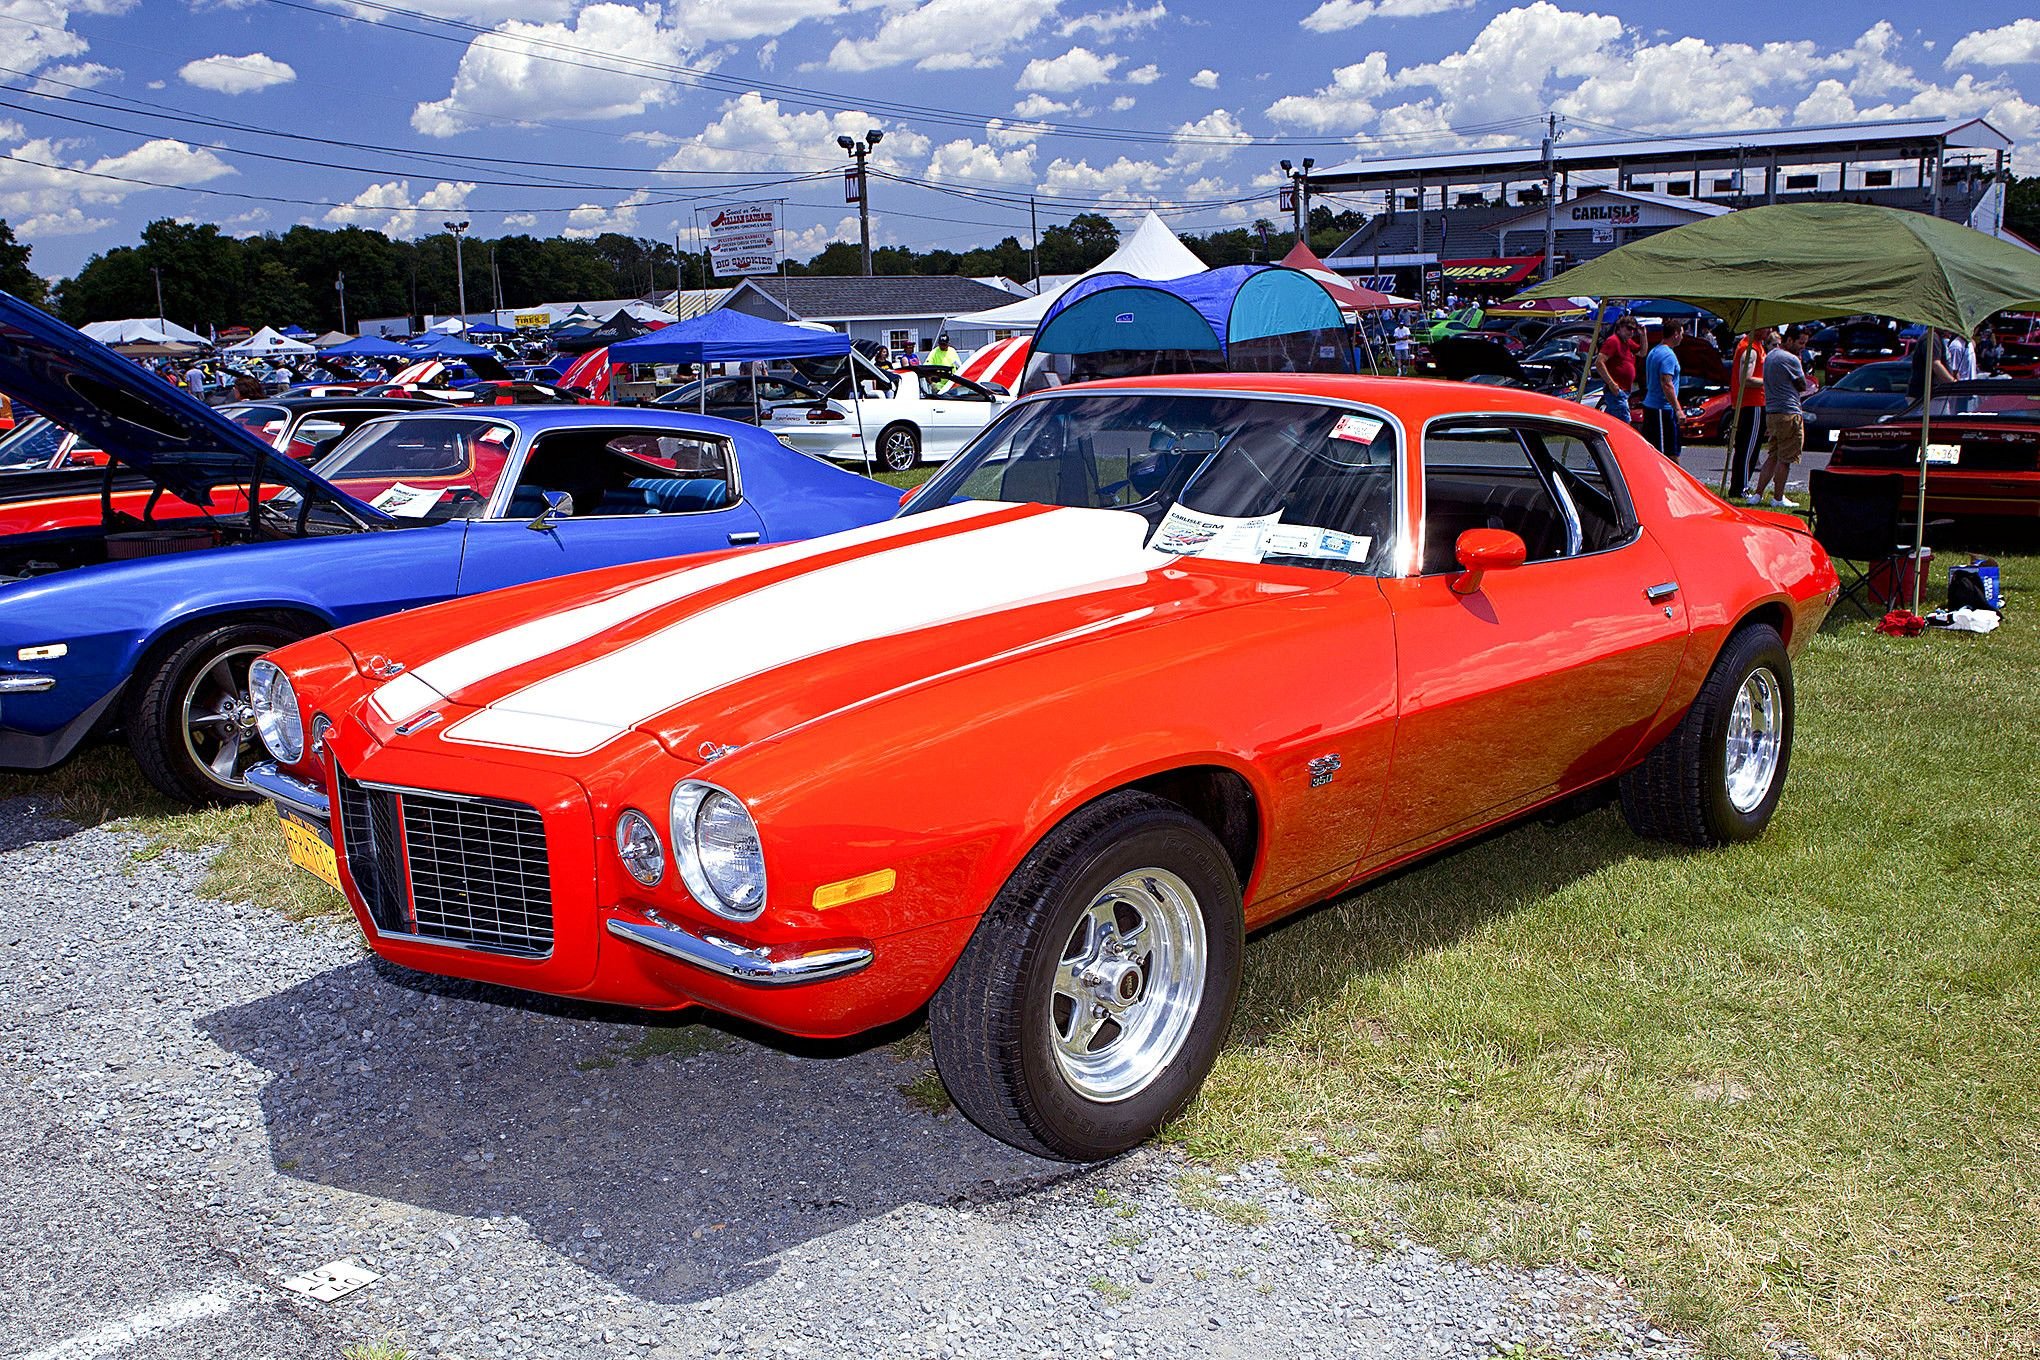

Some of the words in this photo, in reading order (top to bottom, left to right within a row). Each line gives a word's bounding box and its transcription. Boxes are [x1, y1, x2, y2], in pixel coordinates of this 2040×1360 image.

[1572, 205, 1639, 220] CARLISLE
[731, 256, 773, 266] SMOKIES
[1171, 511, 1202, 525] CARLISLE
[1308, 753, 1341, 775] SS
[1311, 773, 1333, 787] 350
